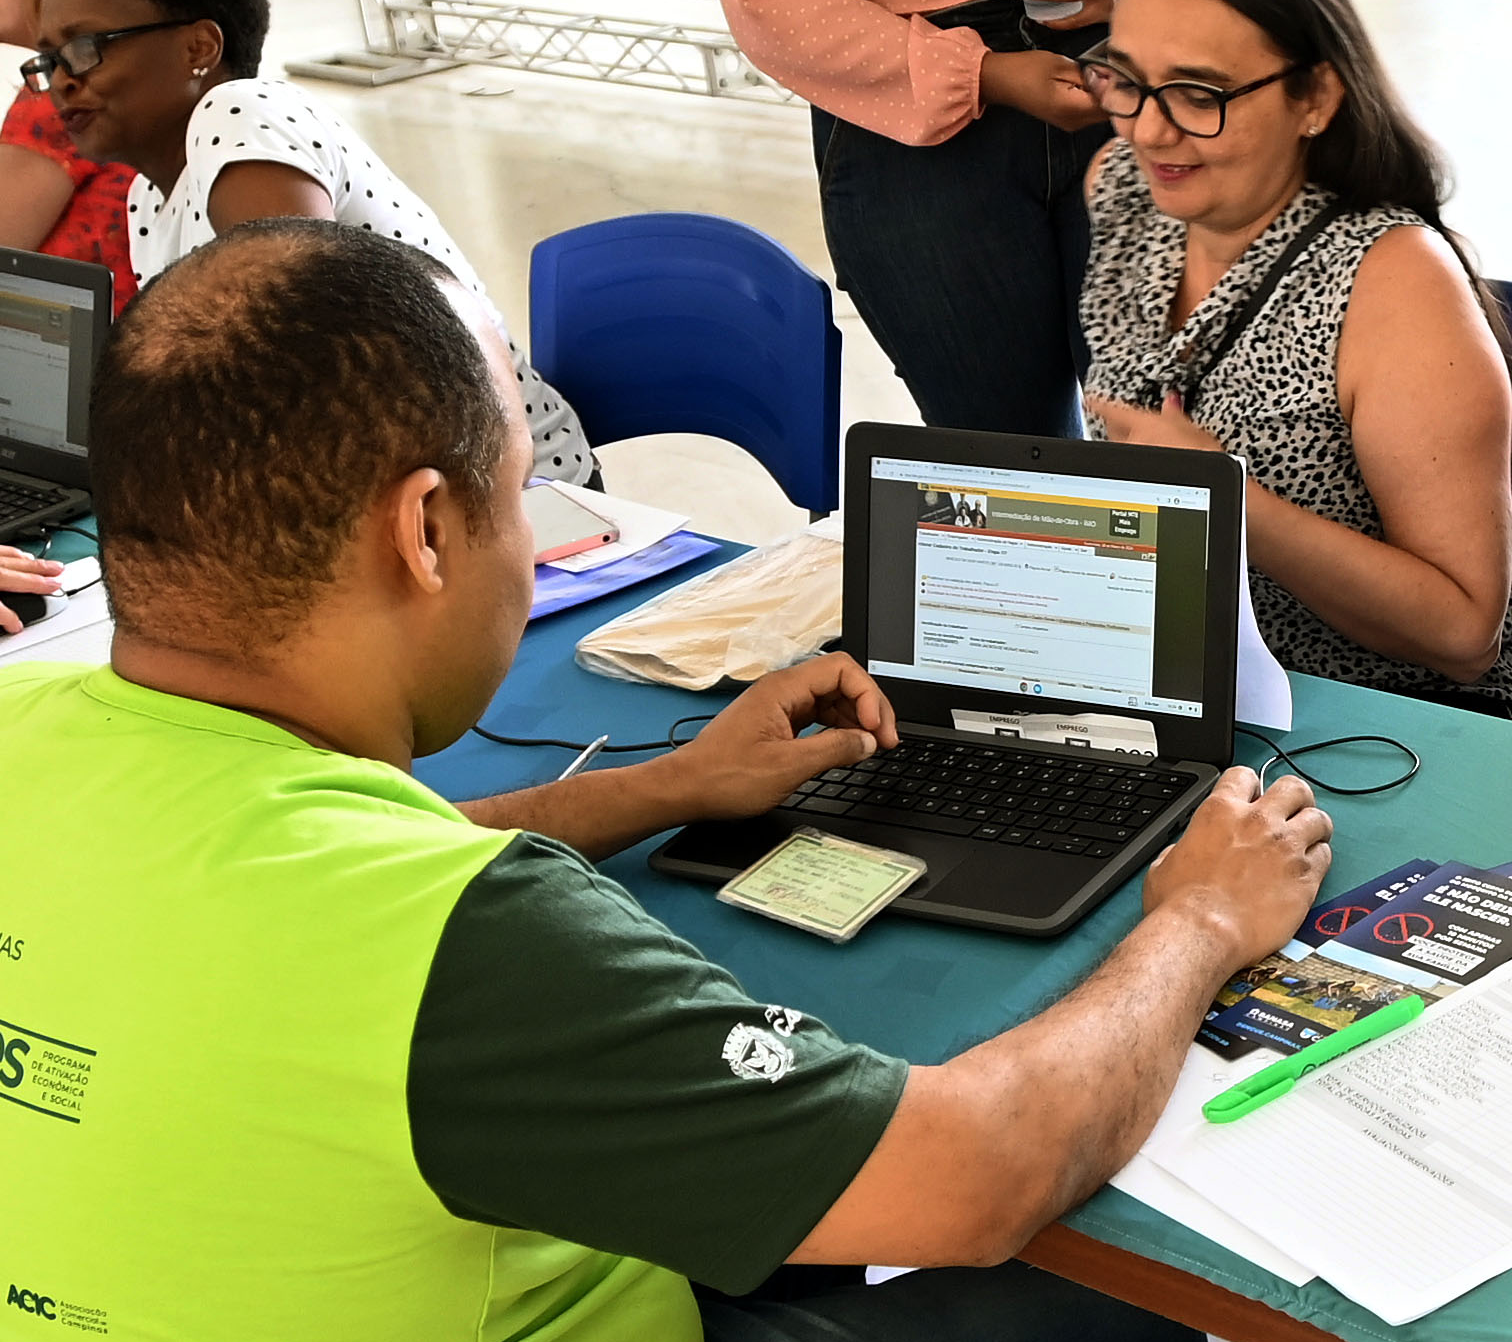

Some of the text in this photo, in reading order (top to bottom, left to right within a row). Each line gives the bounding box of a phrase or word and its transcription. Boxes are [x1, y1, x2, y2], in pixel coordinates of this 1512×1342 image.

[1056, 723, 1089, 734] EMPREGO
[1423, 893, 1453, 907] ELE
[1446, 888, 1481, 904] NÃO
[43, 1050, 91, 1072] PROGRAMA
[31, 1060, 88, 1086] DE ATIVAÇÃO
[32, 1074, 84, 1098] ECONÔMICA
[41, 1091, 81, 1111] E SOCIAL
[6, 1284, 57, 1321] ACIC
